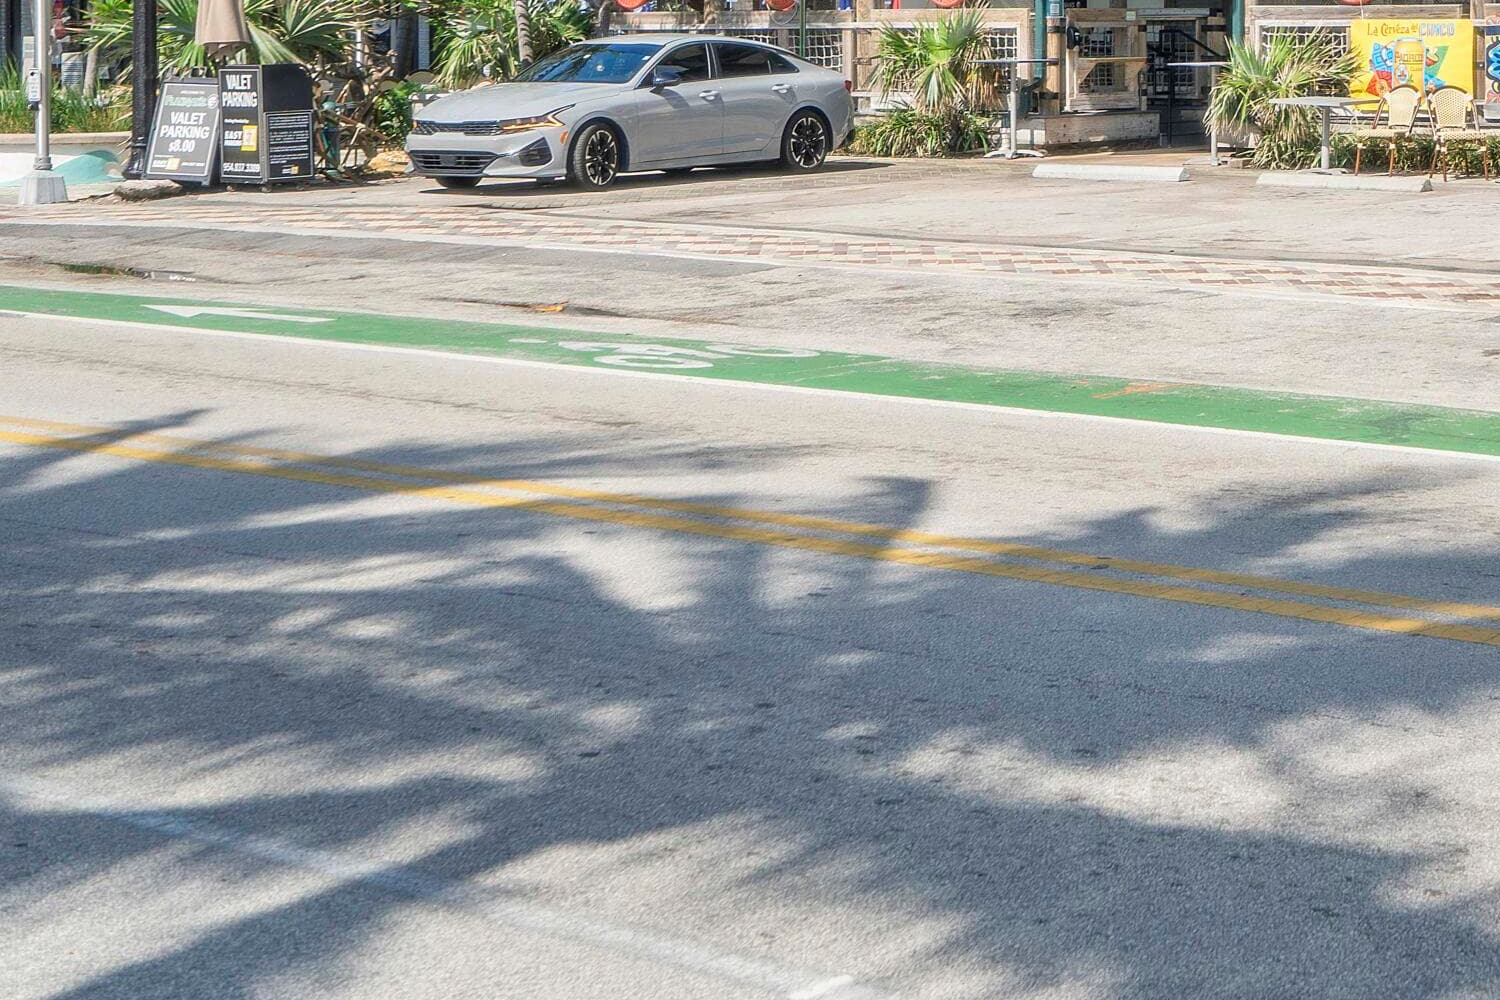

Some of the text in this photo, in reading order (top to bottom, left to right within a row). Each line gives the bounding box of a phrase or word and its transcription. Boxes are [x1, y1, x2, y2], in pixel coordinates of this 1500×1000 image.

[225, 74, 252, 90] VALET
[222, 91, 258, 108] PARKING
[171, 111, 207, 125] VALET
[160, 125, 210, 139] PARKING
